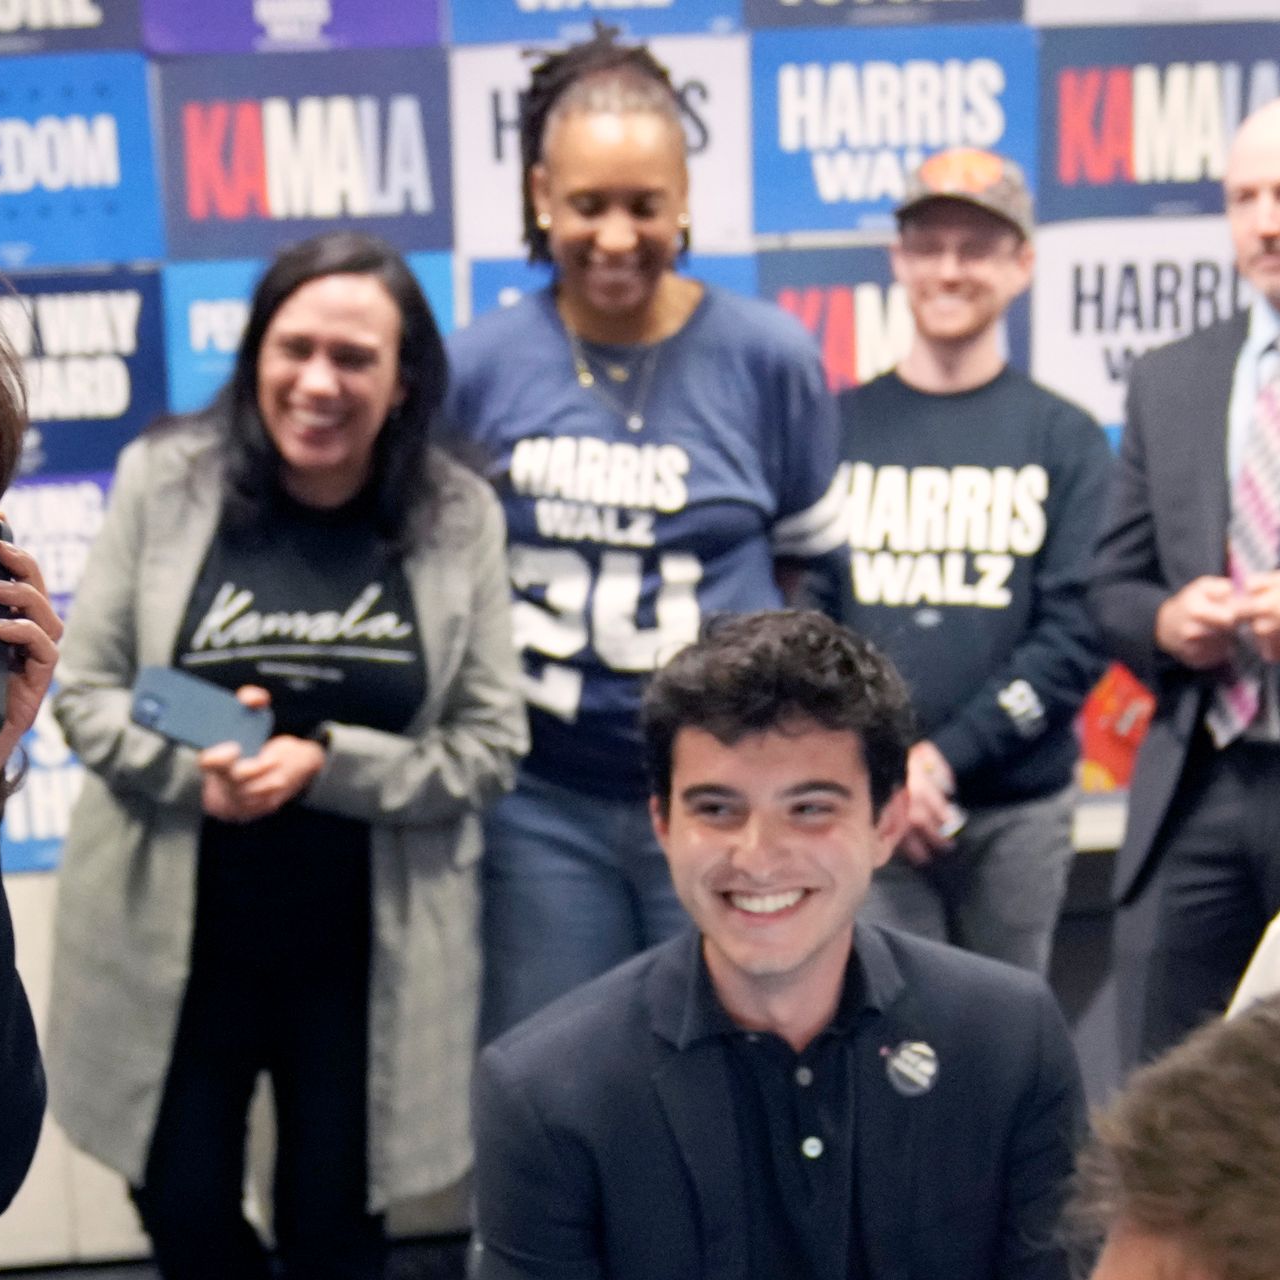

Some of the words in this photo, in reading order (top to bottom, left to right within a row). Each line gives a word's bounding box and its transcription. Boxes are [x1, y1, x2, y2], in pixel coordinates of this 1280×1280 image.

[779, 59, 1005, 151] HARRIS
[183, 94, 433, 221] KAMALA
[1073, 262, 1239, 332] HARRI
[511, 436, 689, 514] HARRIS
[535, 500, 656, 547] WALZ
[852, 552, 1014, 608] WALZ
